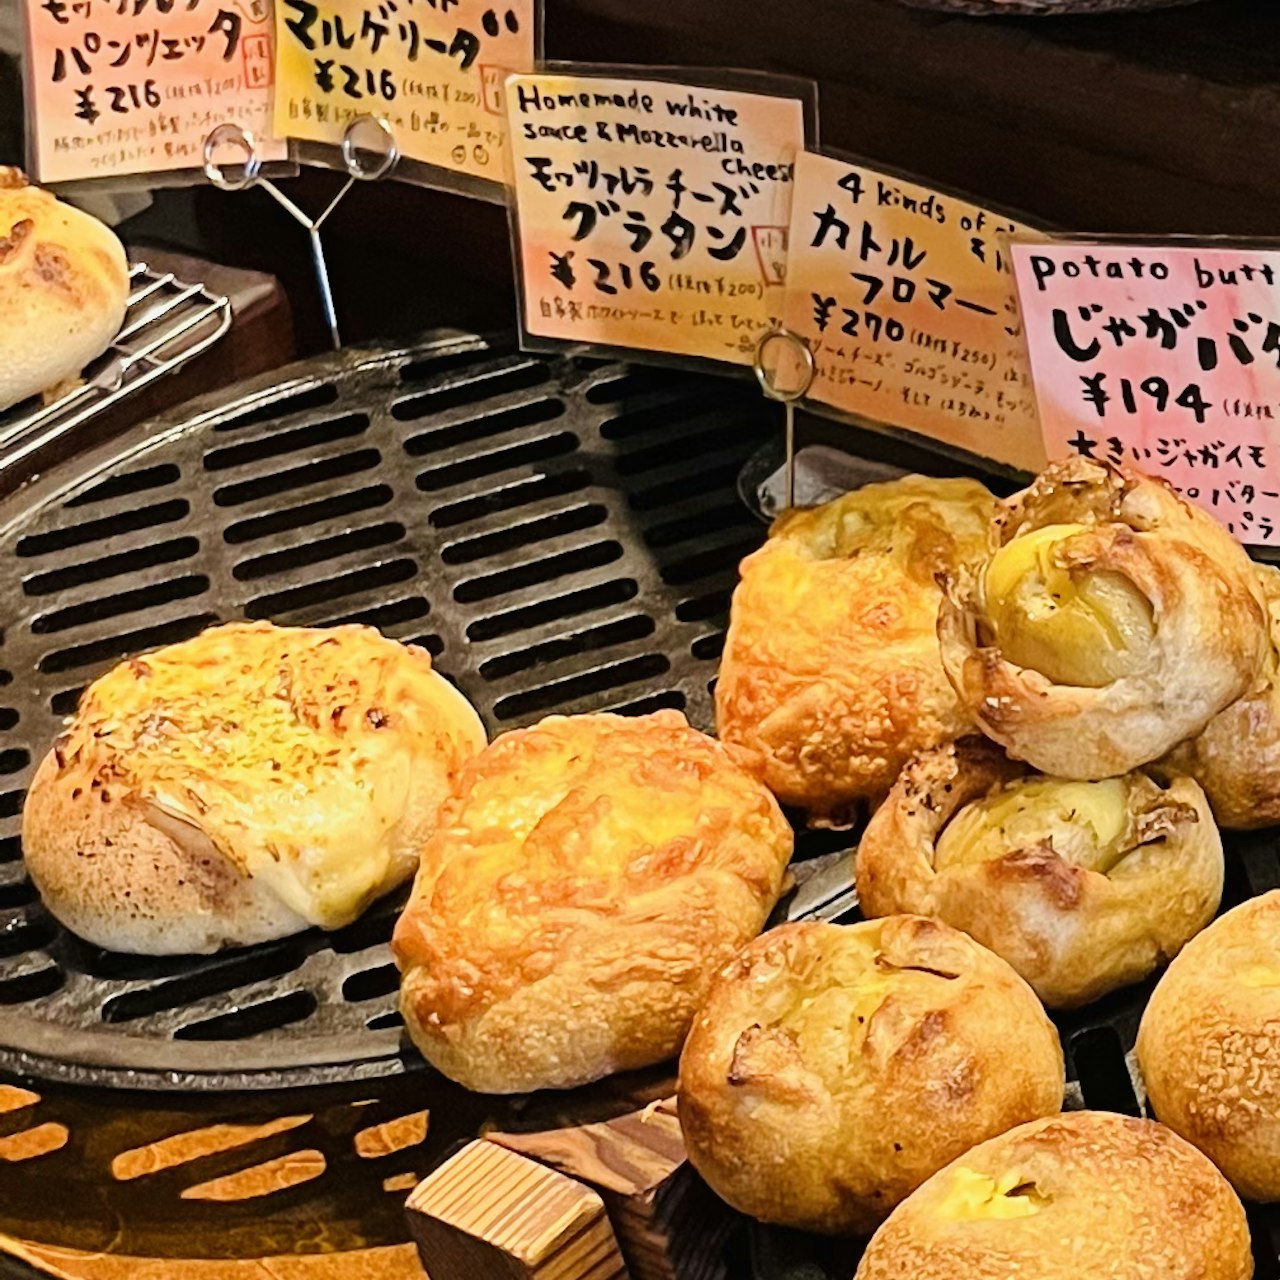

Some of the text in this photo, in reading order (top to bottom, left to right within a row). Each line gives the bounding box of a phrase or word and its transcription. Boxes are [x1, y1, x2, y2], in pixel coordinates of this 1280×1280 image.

[51, 8, 243, 83] パンツェッタ
[74, 79, 162, 126] ¥216
[313, 58, 398, 101] ¥216
[518, 86, 654, 114] Homemade
[666, 97, 739, 126] white
[523, 121, 744, 154] sauce & Mozzarella
[837, 172, 987, 232] 4 kinds of
[562, 200, 747, 261] グラタン
[810, 203, 927, 270] カトル
[548, 250, 661, 296] ¥216
[811, 292, 905, 343] ¥270
[1079, 372, 1214, 424] ¥194
